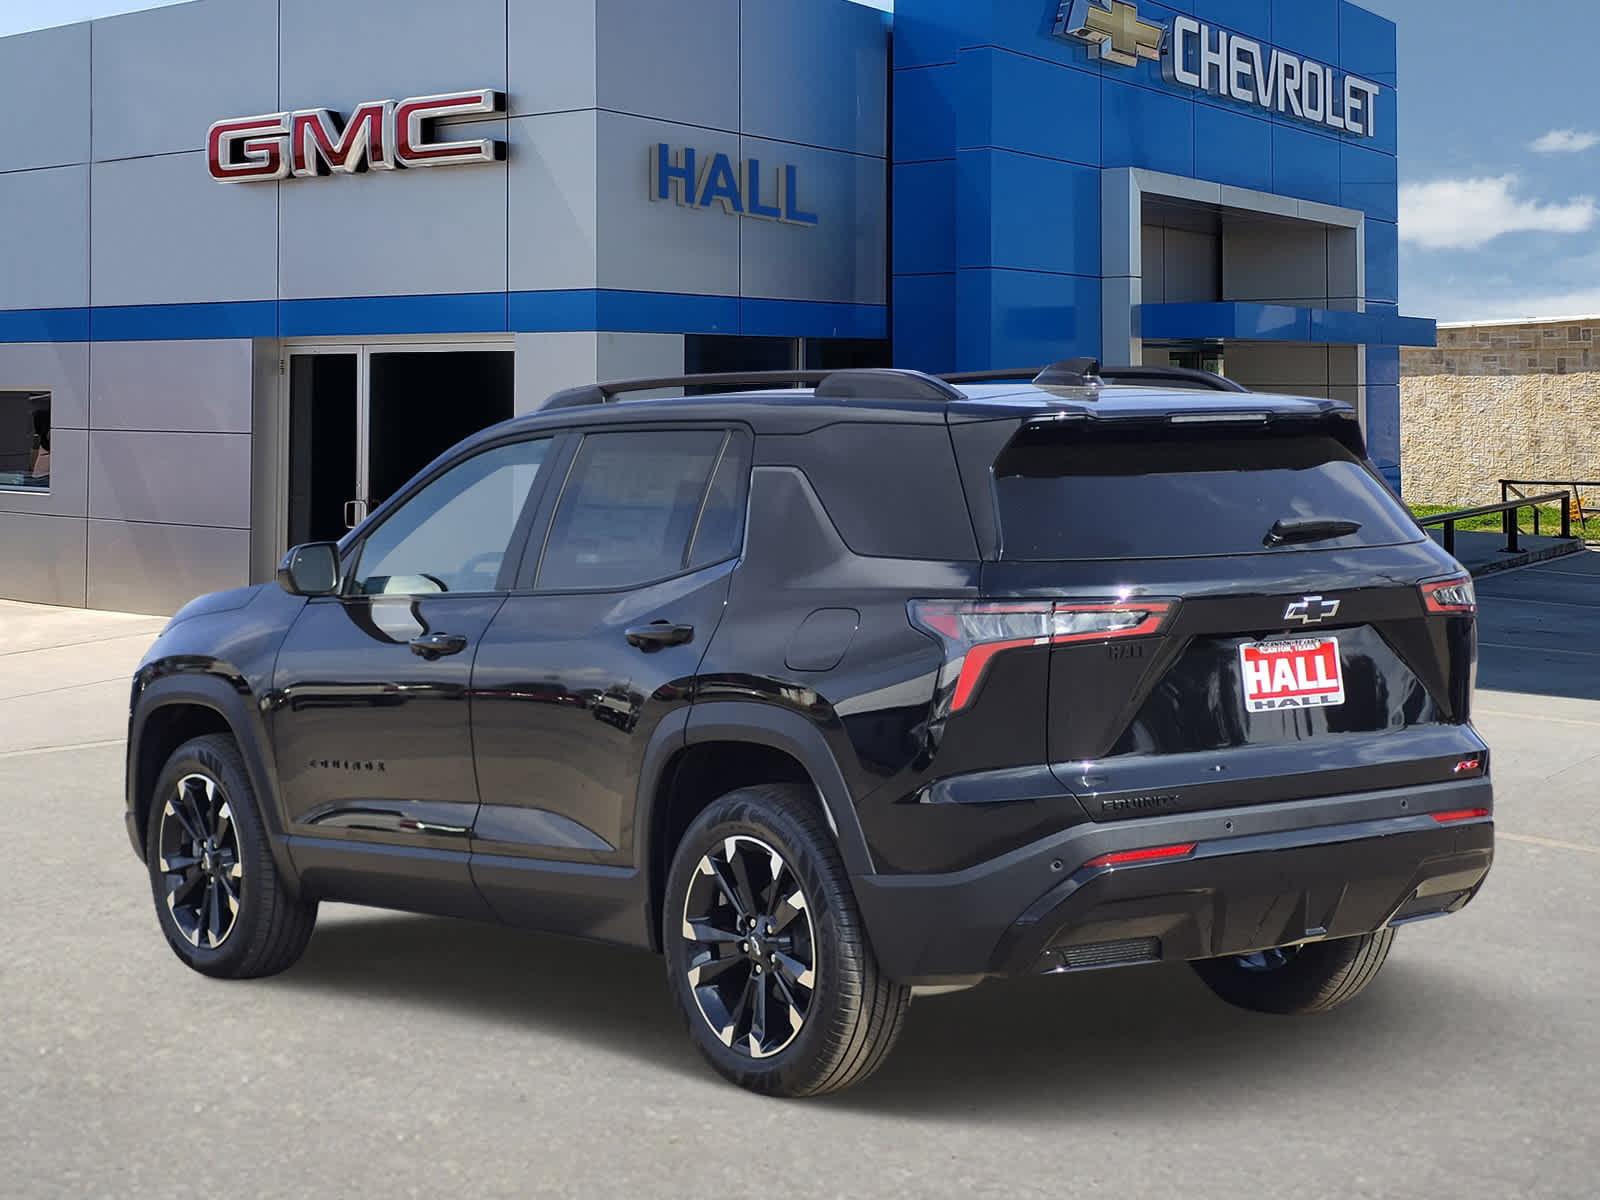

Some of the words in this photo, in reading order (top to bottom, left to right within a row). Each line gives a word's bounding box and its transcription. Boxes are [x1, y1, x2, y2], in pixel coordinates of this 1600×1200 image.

[1174, 15, 1379, 137] CHEVROLET
[207, 88, 506, 185] GMC
[650, 142, 818, 226] HALL
[1245, 655, 1339, 694] HALL
[1254, 695, 1339, 710] HALL
